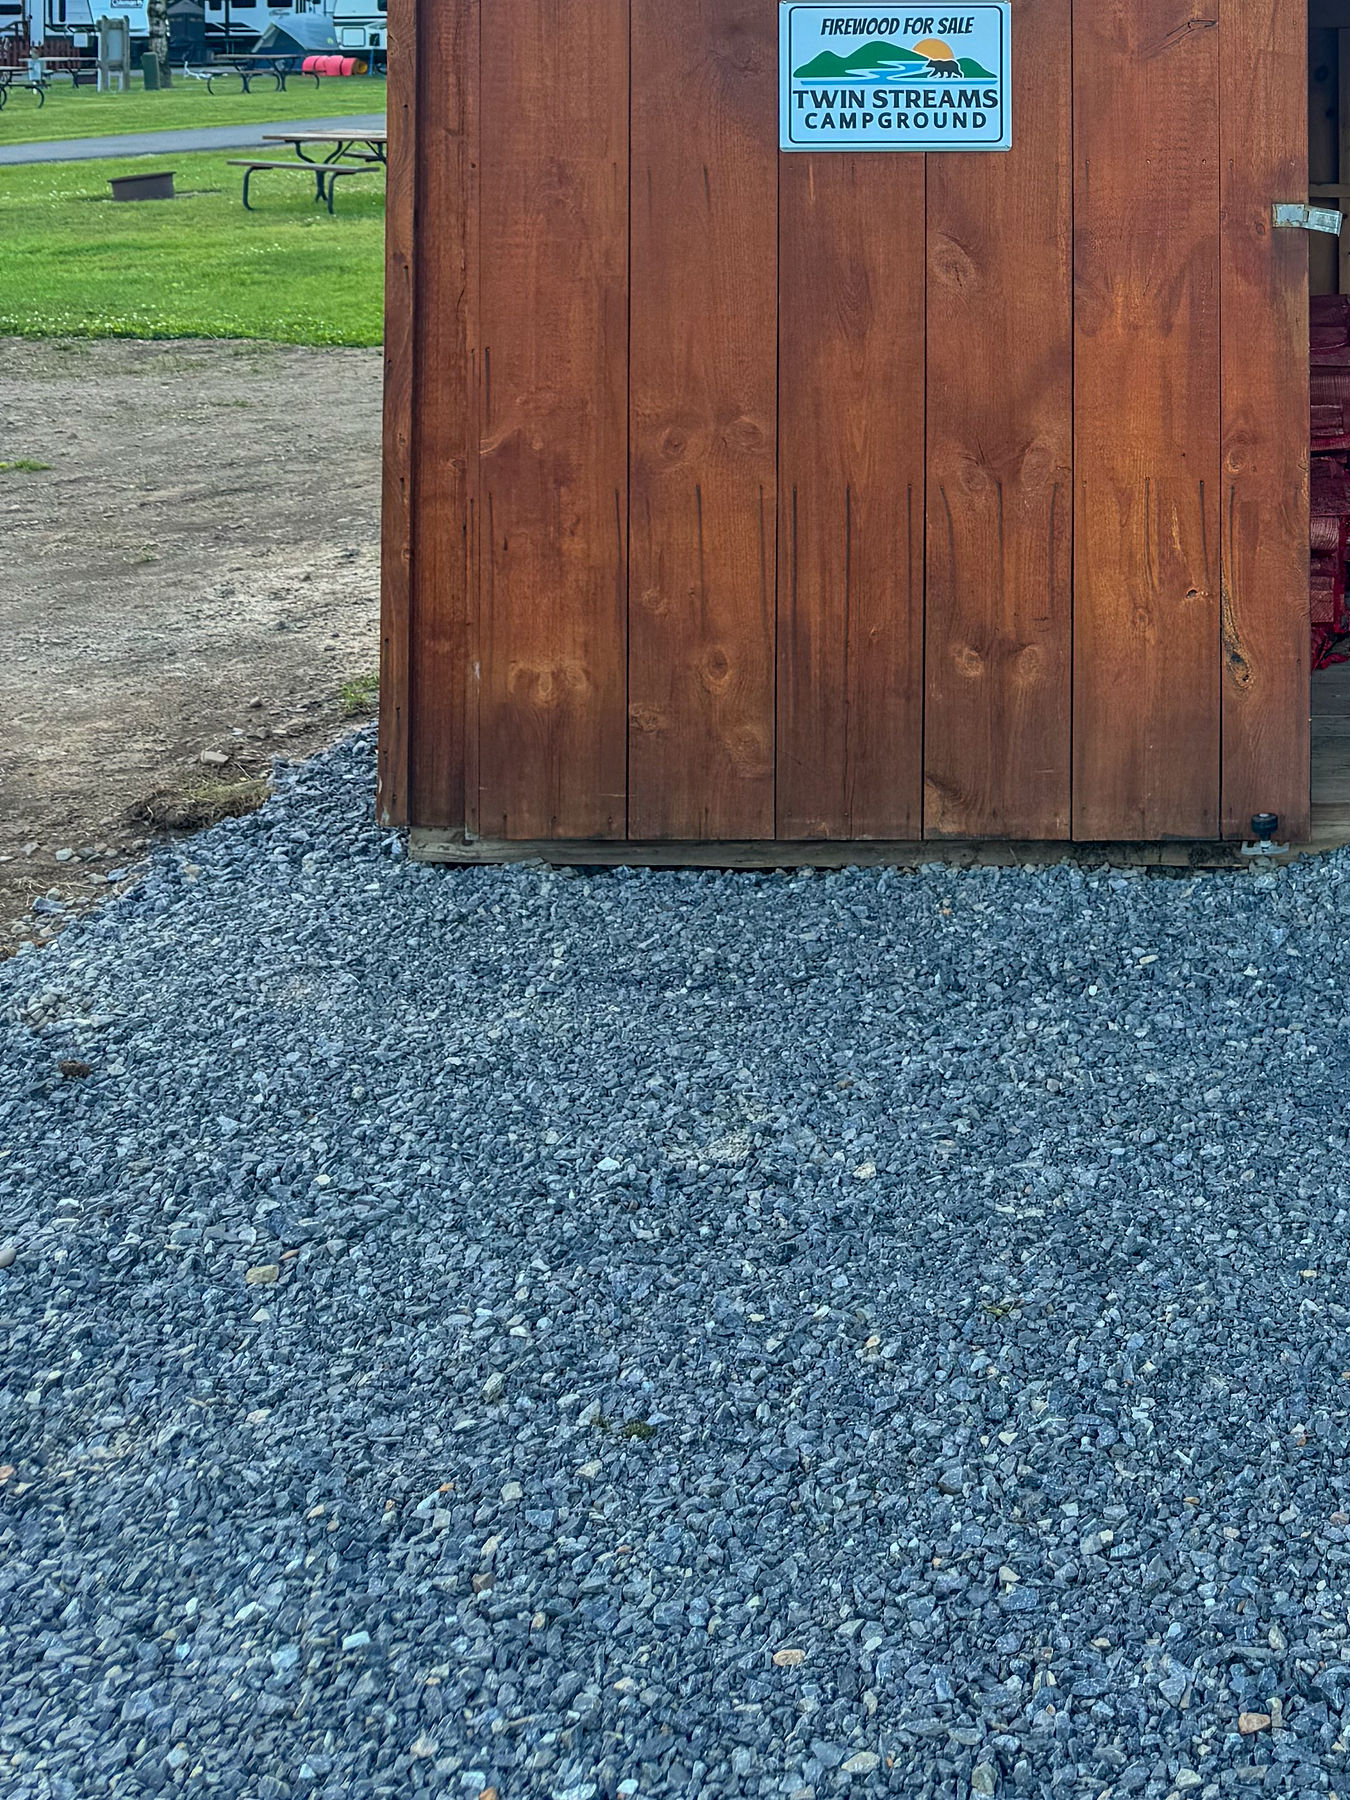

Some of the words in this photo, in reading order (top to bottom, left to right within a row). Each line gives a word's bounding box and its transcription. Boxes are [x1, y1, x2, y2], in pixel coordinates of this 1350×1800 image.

[820, 17, 900, 35] FIREWOOD
[903, 17, 934, 35] FOR
[937, 16, 975, 34] SALE
[793, 89, 865, 109] TWIN
[872, 89, 998, 109] STREAMS
[804, 112, 987, 129] CAMPGROUND
